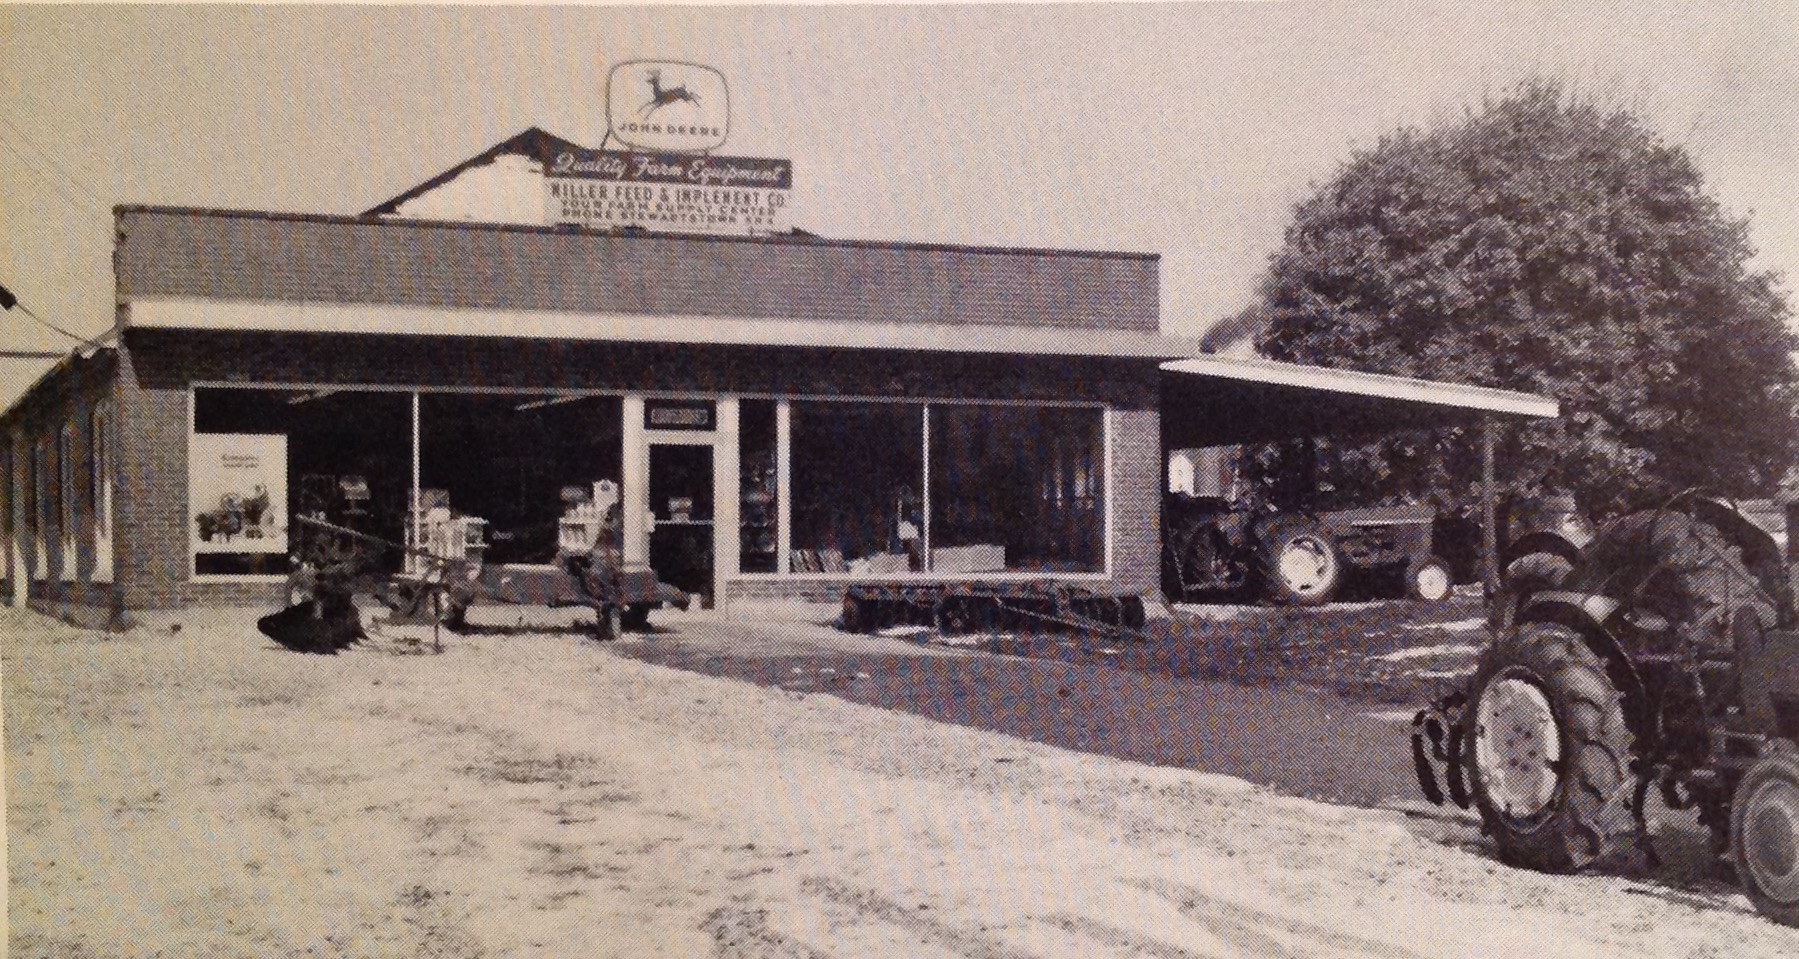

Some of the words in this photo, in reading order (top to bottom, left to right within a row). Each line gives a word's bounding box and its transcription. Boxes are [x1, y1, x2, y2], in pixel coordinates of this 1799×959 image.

[618, 123, 661, 134] JOHN
[667, 124, 720, 137] DEERE
[550, 152, 627, 179] Quality
[632, 155, 683, 176] Farm
[687, 160, 785, 185] Equipment
[551, 183, 607, 199] MILLER
[615, 185, 652, 200] FEED
[660, 187, 669, 202] &
[677, 189, 759, 205] IMPLEMENT
[561, 200, 602, 209] YOUR
[608, 201, 648, 210] FARM
[655, 202, 711, 213] SUPPLY
[719, 206, 775, 216] CENTER
[562, 208, 612, 219] PHONE
[621, 211, 737, 223] STEWARTSTOWN
